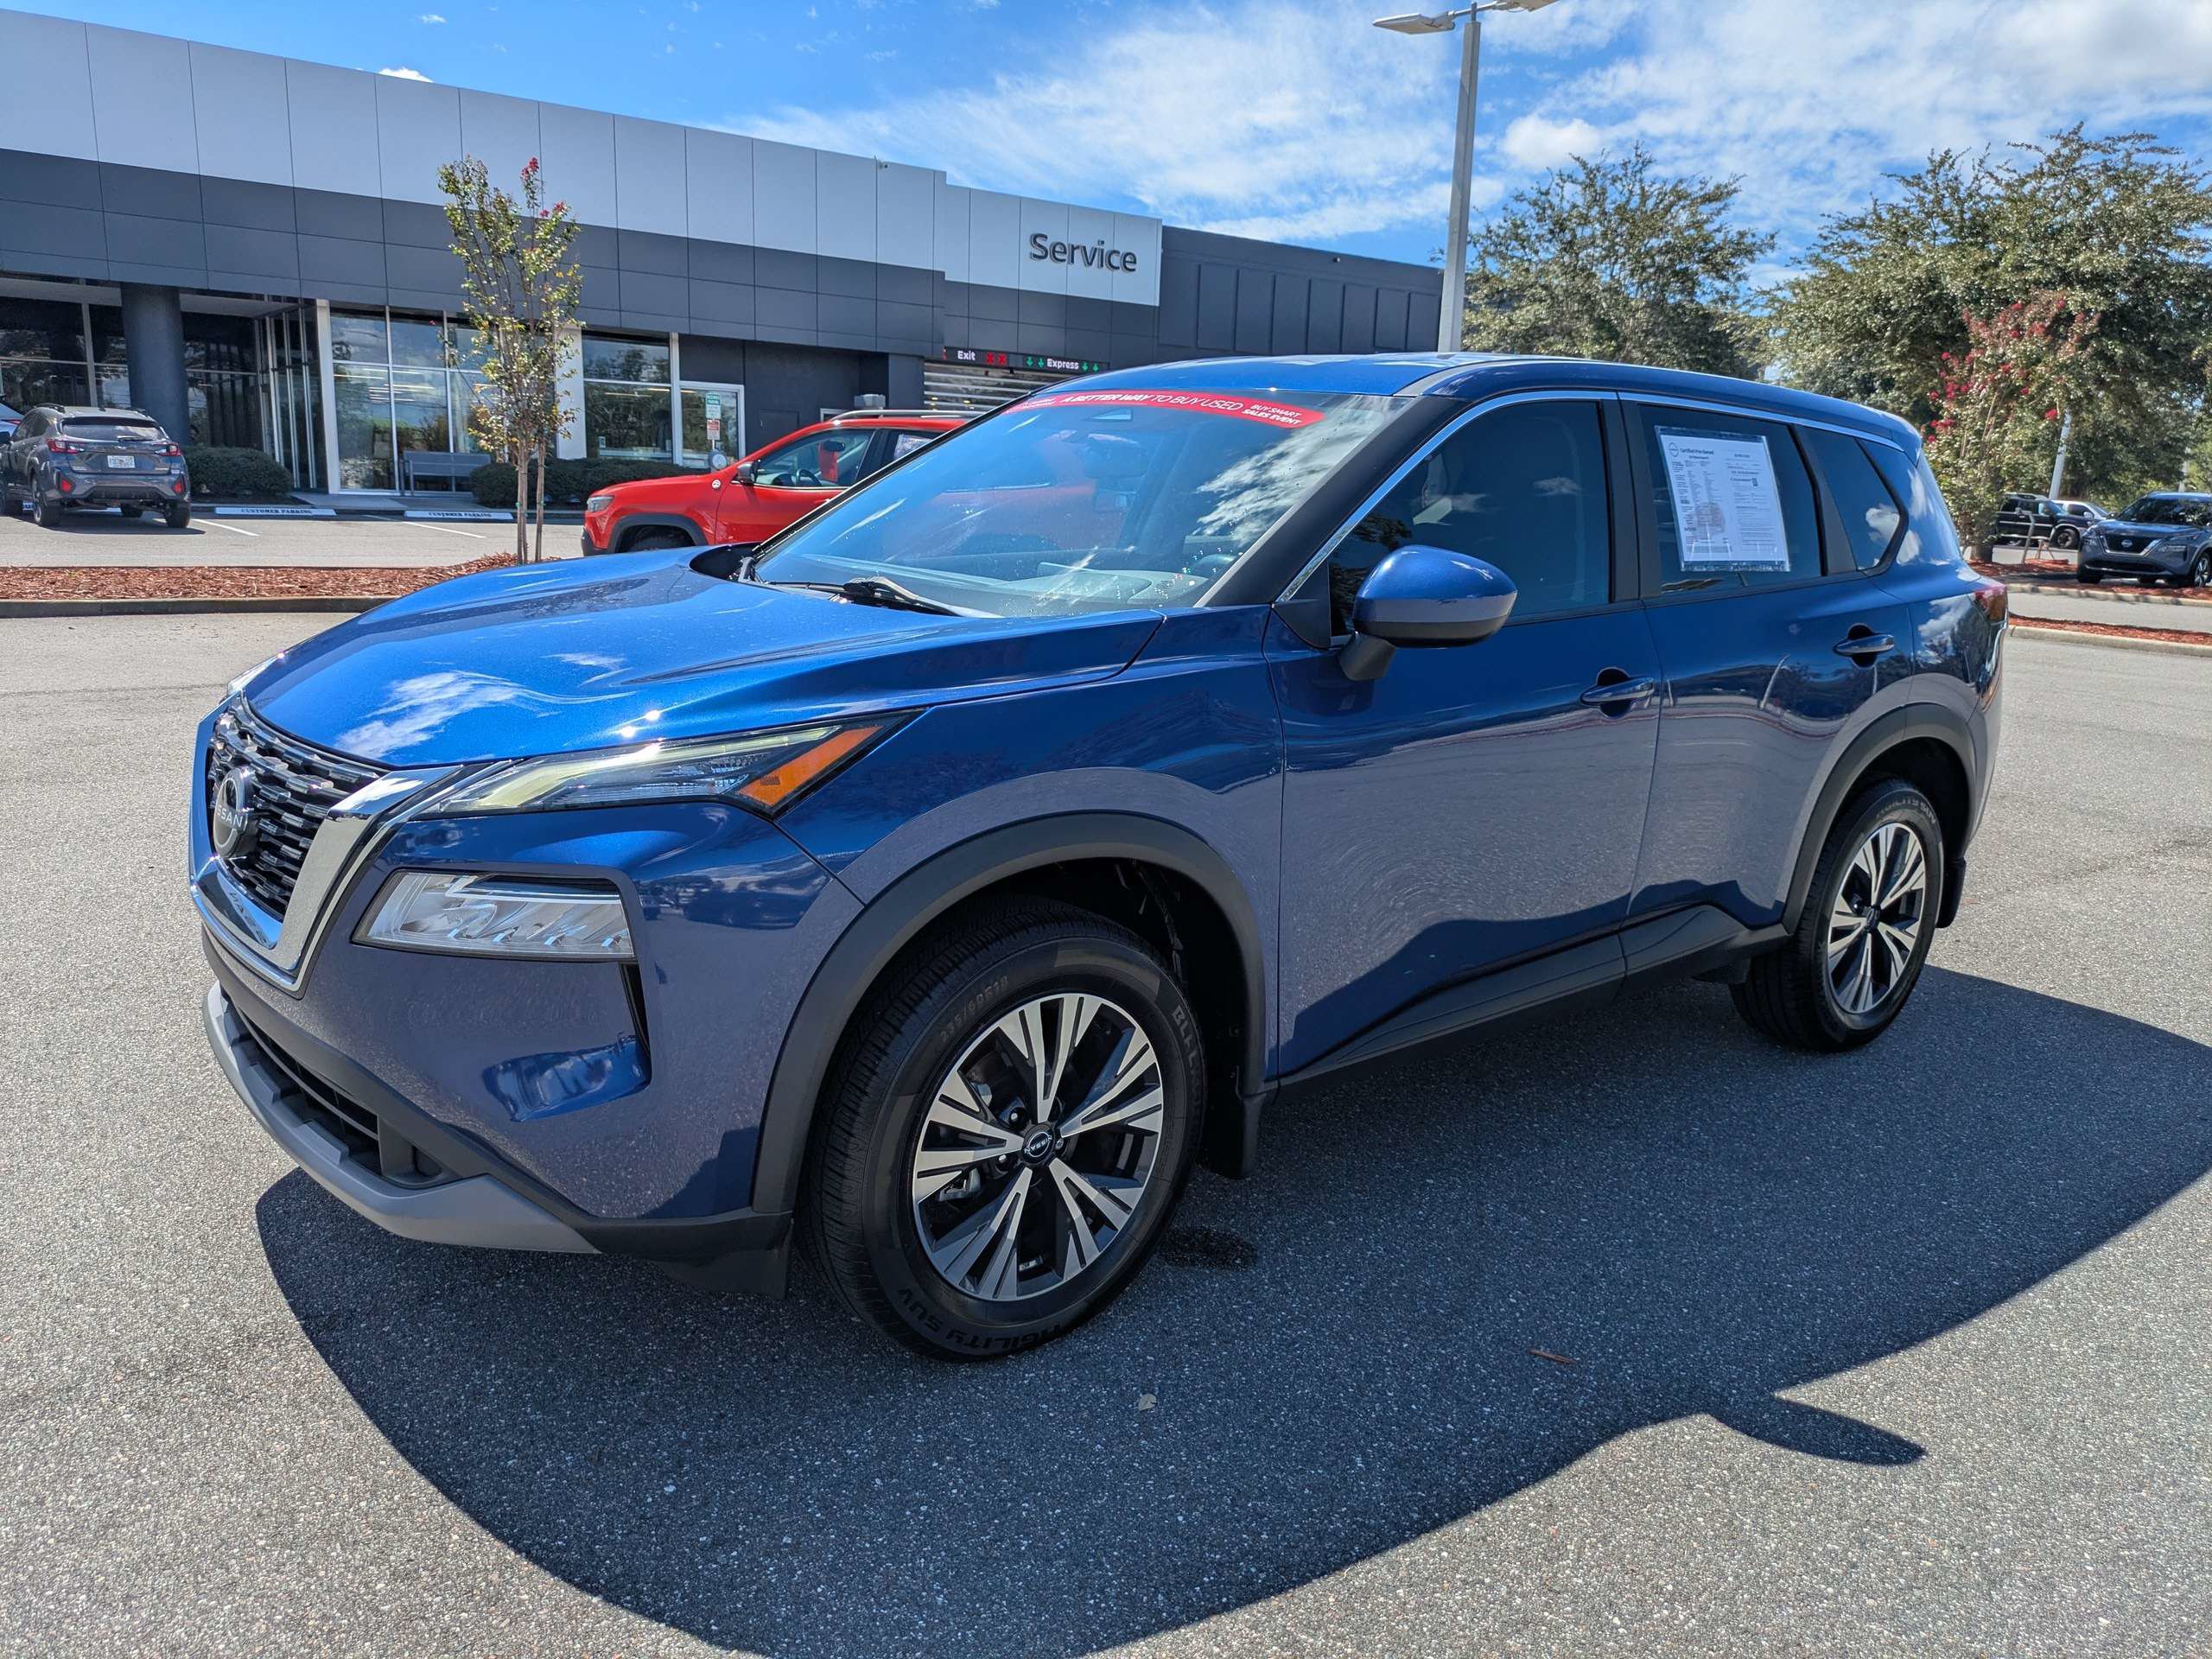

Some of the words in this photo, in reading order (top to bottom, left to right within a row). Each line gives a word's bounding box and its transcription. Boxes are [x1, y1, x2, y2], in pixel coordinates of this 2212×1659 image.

[1029, 232, 1137, 272] Service
[957, 350, 976, 361] Exit
[1046, 358, 1079, 370] Express
[1152, 394, 1172, 403] TO
[1172, 395, 1205, 405] BUY
[1201, 397, 1244, 411] USED
[1242, 409, 1272, 418] SALES
[1269, 414, 1302, 425] EVENT
[1268, 407, 1302, 418] SMART
[216, 804, 244, 828] SSAN
